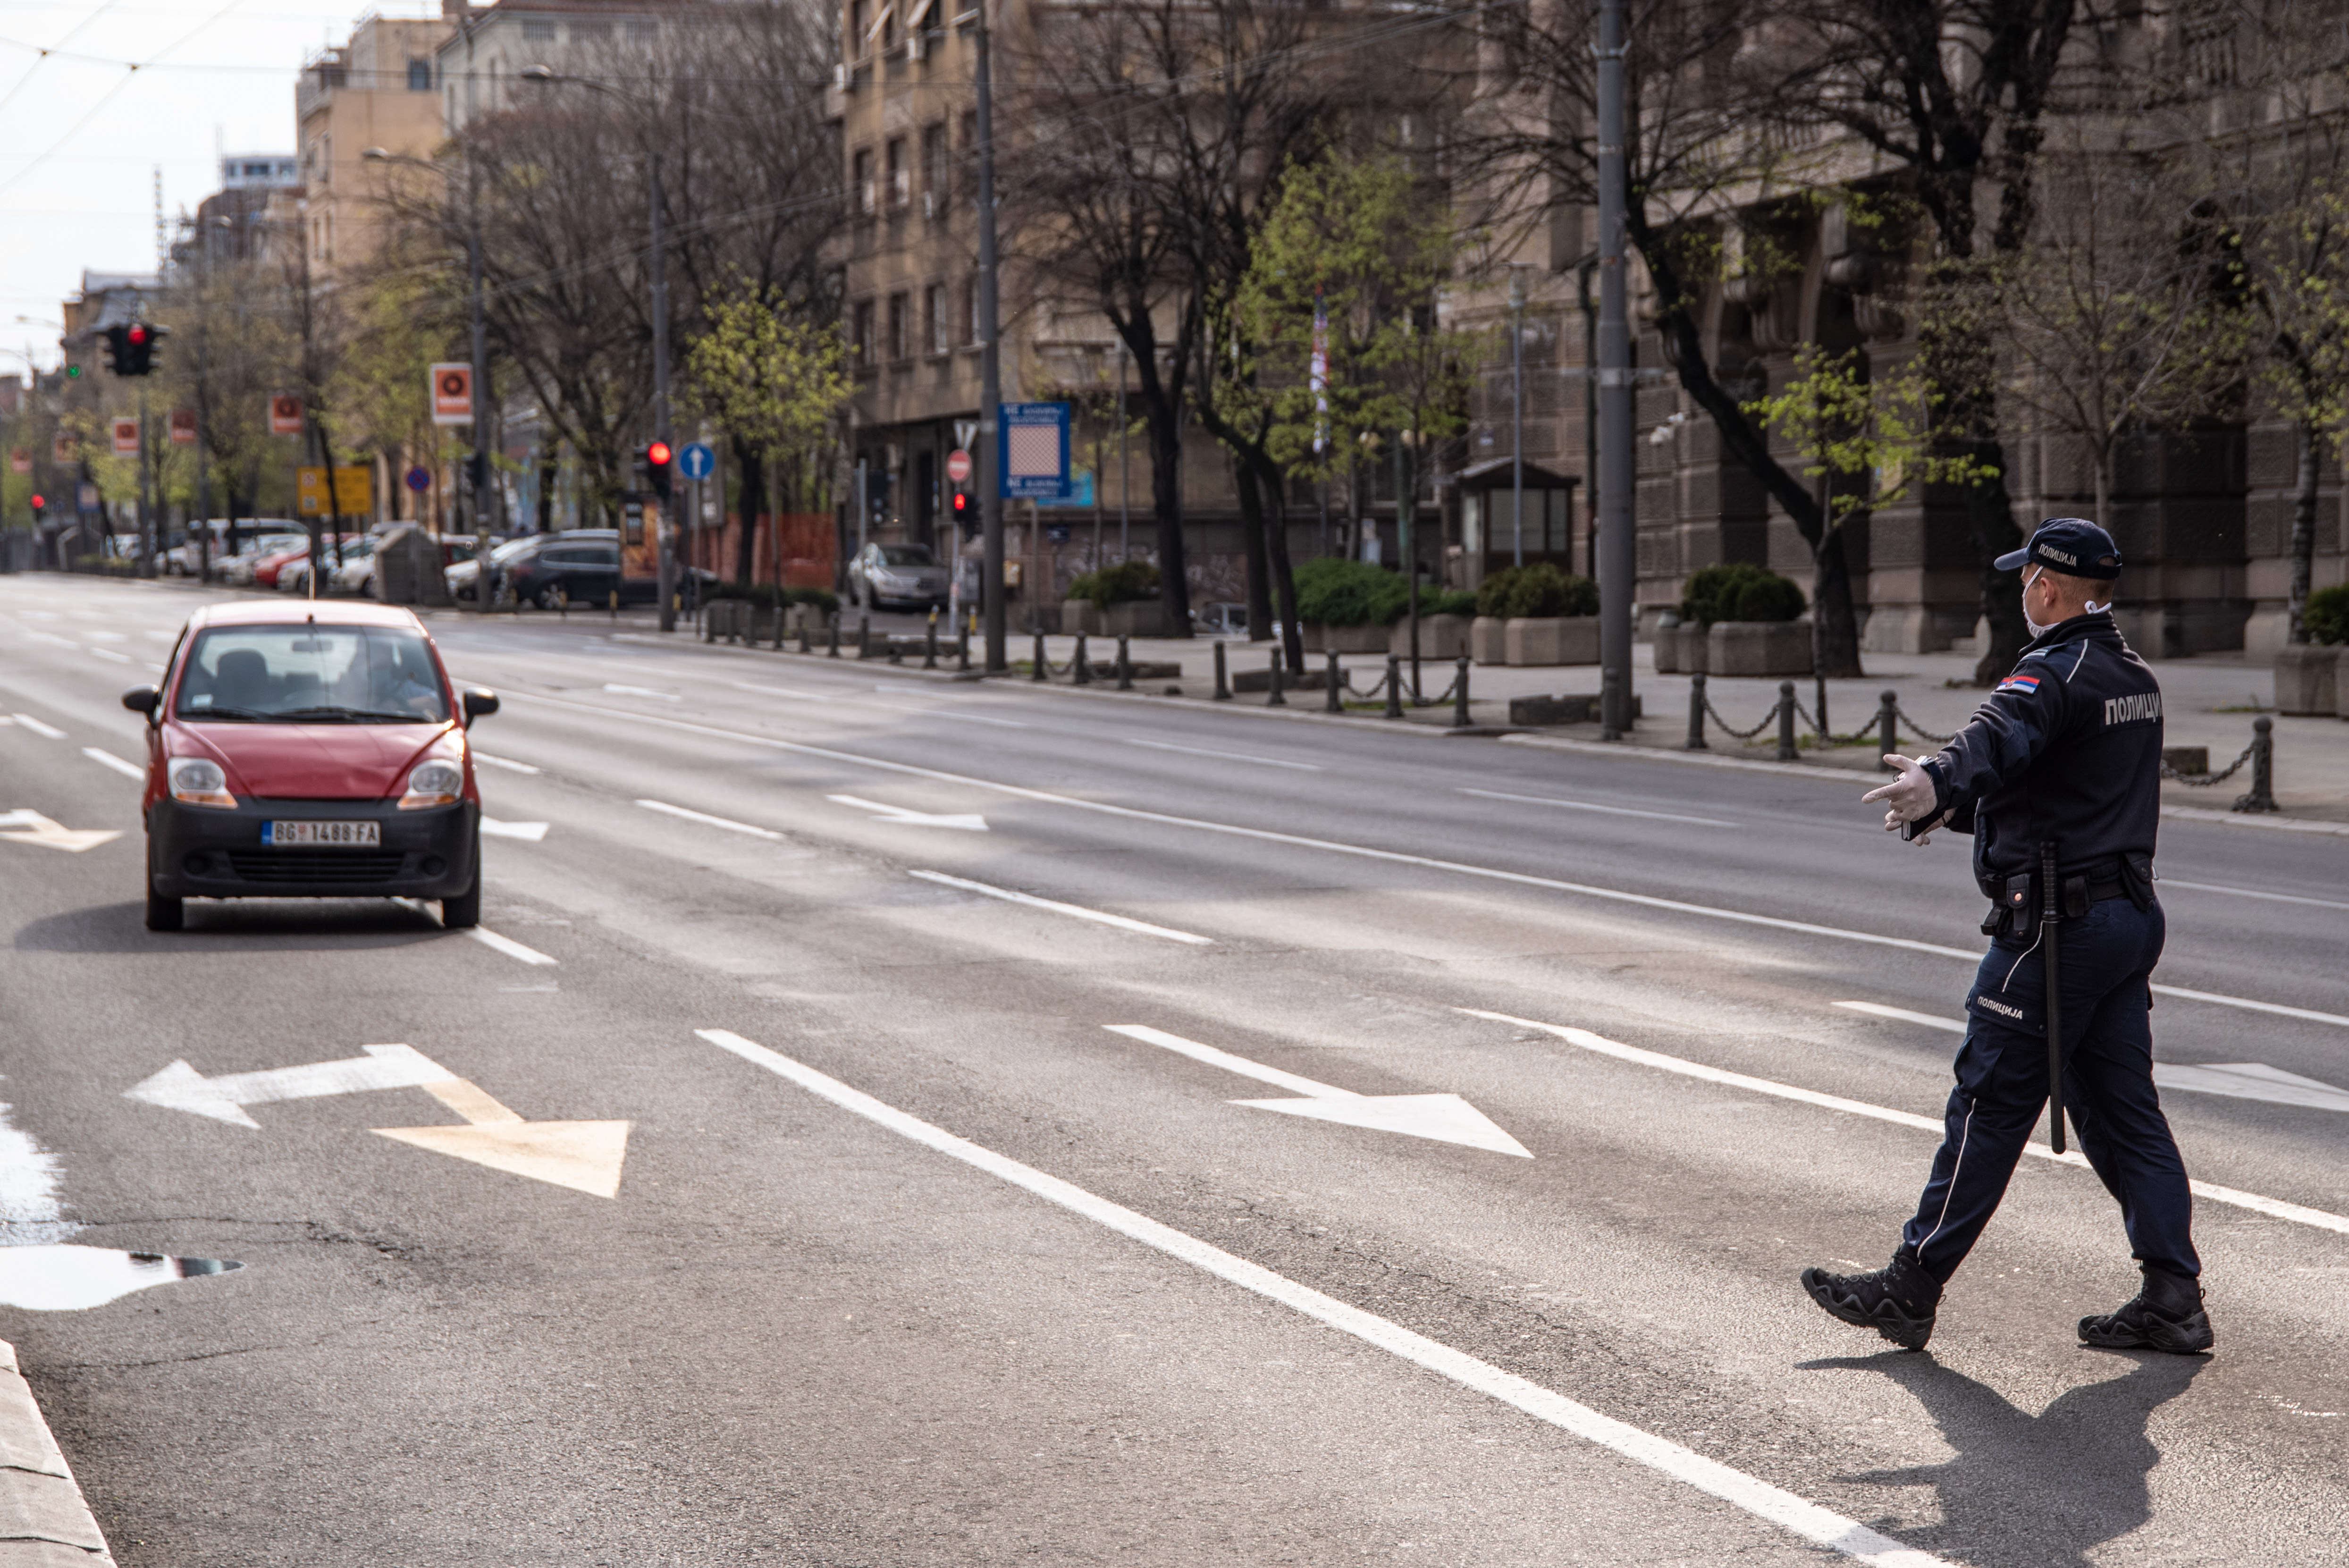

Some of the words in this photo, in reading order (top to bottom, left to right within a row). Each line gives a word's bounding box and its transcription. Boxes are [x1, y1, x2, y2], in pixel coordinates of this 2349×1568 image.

[2038, 543, 2077, 566] ПОЛИЦИЈА
[2105, 692, 2163, 725] ПОЛИЦИ
[275, 823, 295, 841] BG
[1977, 996, 2022, 1020] ПОЛИЦИЈА
